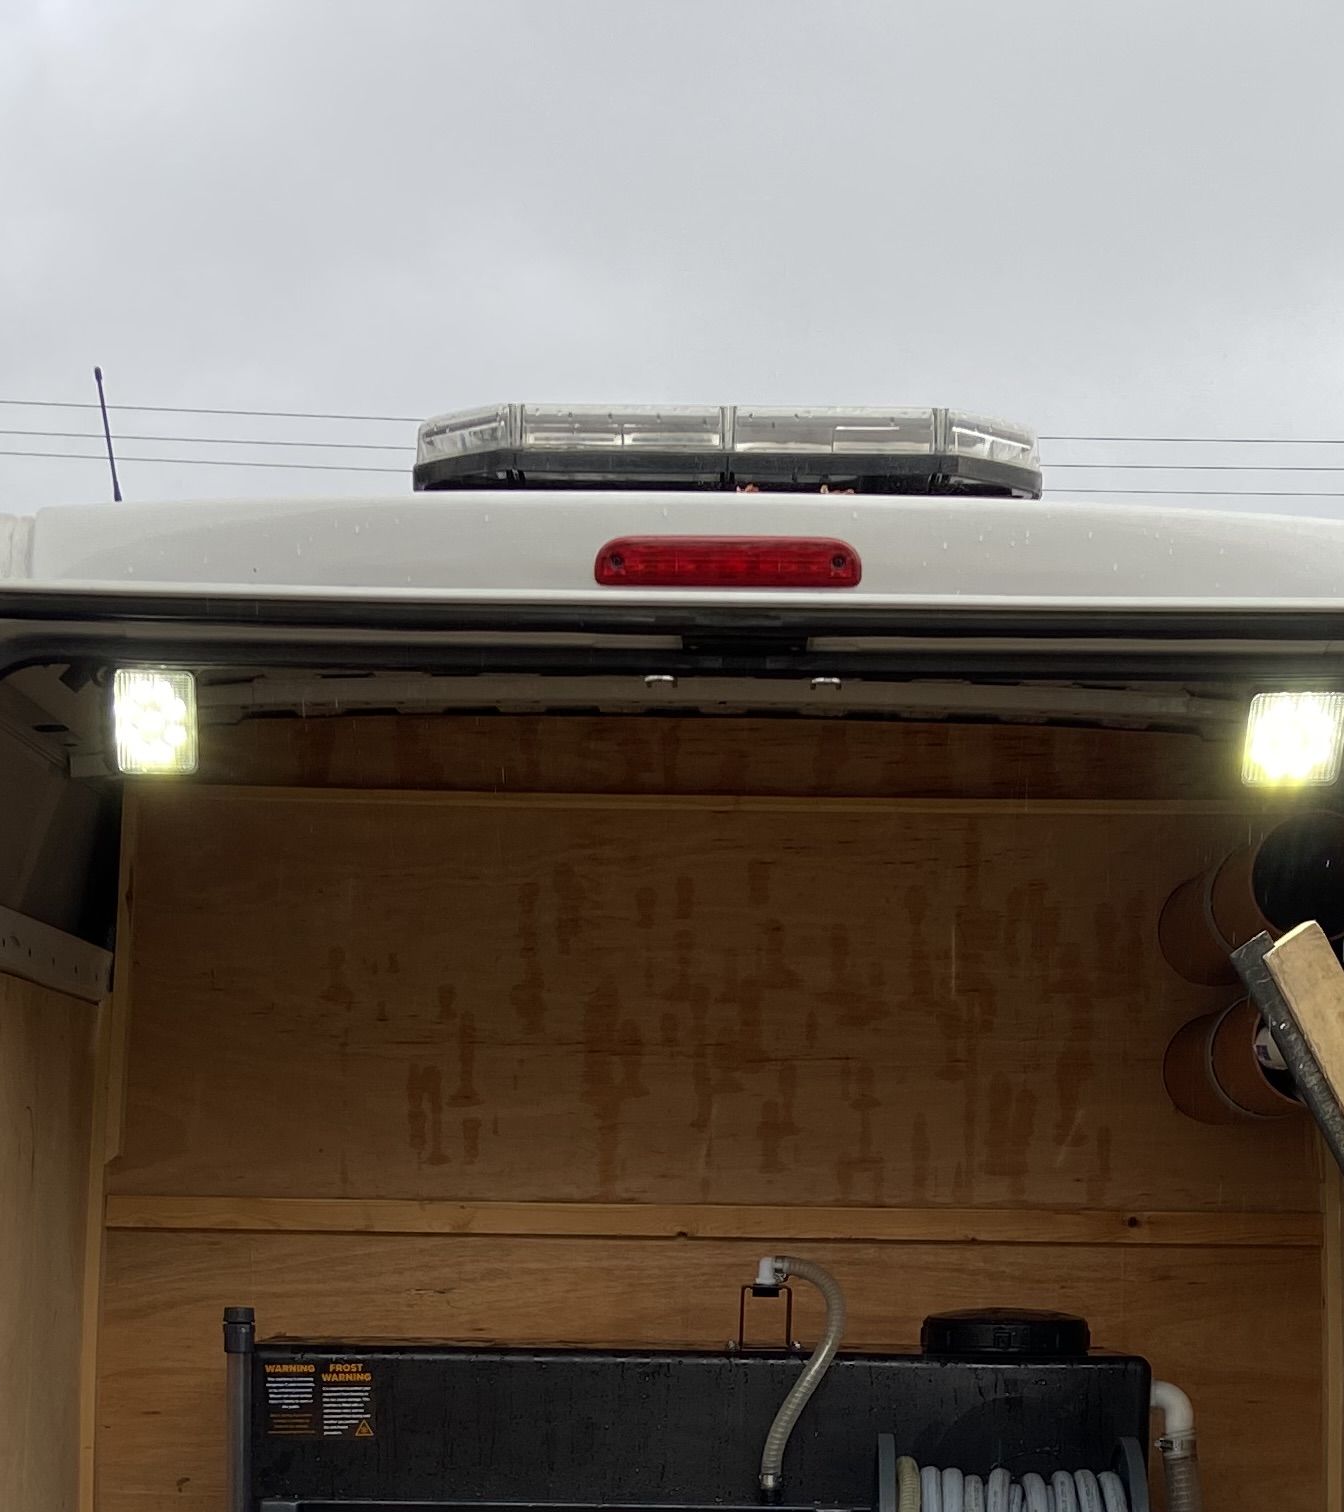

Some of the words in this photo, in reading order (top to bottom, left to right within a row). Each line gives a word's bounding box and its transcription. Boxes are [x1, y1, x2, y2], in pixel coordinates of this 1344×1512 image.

[265, 1364, 315, 1373] WARNING
[329, 1363, 363, 1372] FROST
[321, 1373, 371, 1382] WARNING
